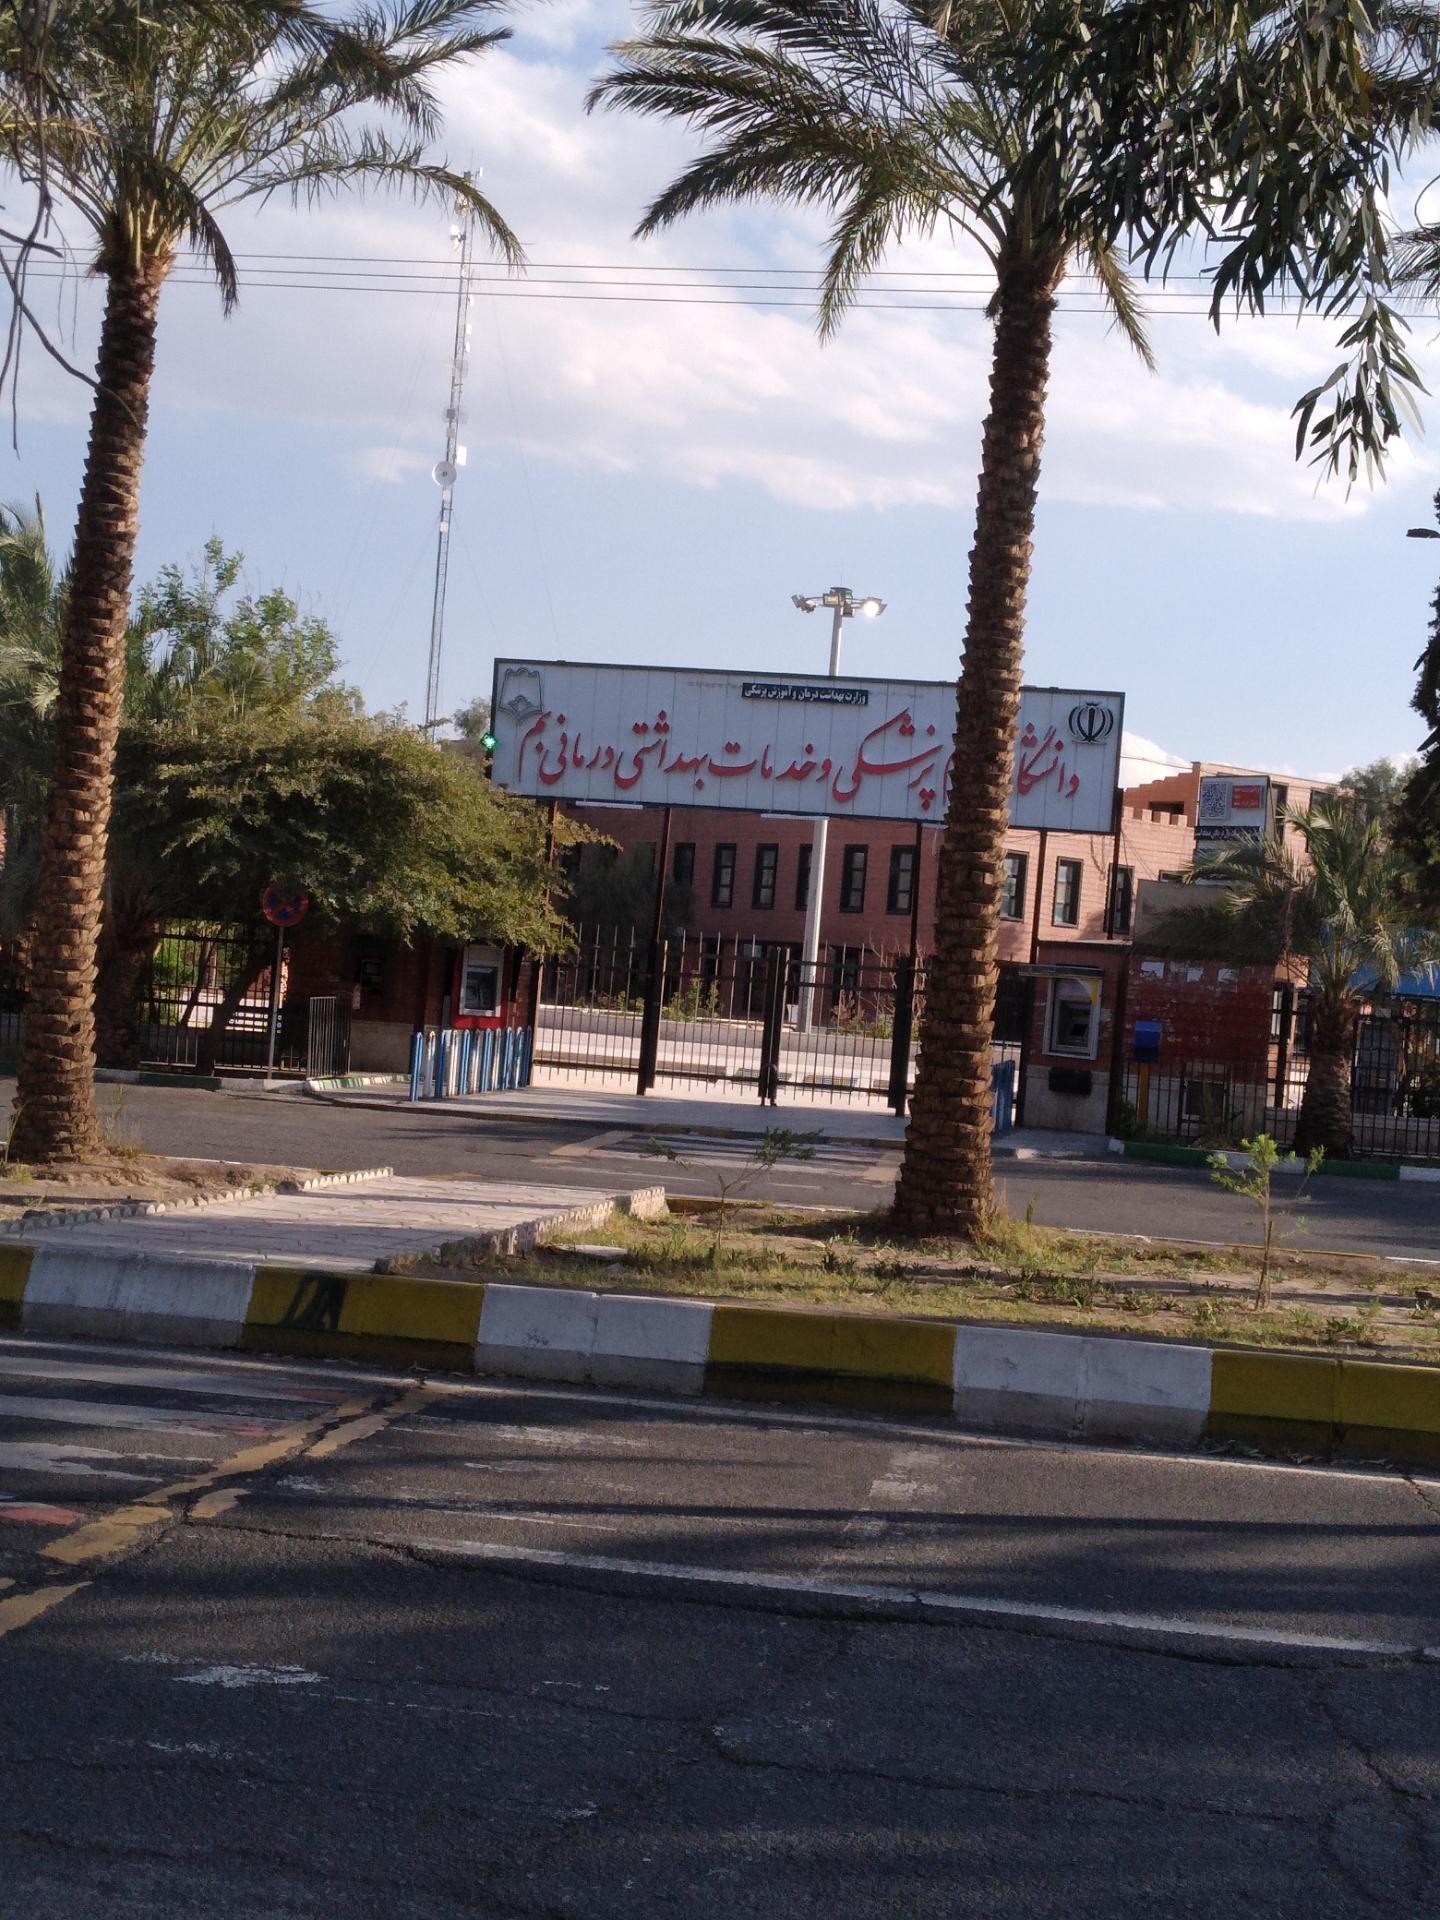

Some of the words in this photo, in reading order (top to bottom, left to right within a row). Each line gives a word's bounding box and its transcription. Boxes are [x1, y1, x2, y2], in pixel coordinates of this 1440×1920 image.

[744, 684, 767, 698] پزشکی
[767, 685, 792, 699] آموزش
[798, 687, 819, 701] درمان
[820, 689, 845, 702] بهداشت
[845, 691, 866, 705] وزارت
[518, 711, 551, 783] بم
[539, 713, 615, 785] درمانی
[614, 710, 708, 790] بهداشتی
[708, 741, 817, 781] خدمات
[832, 707, 944, 811] پزشکی
[1017, 722, 1080, 798] دانشگا
[816, 757, 832, 783] و
